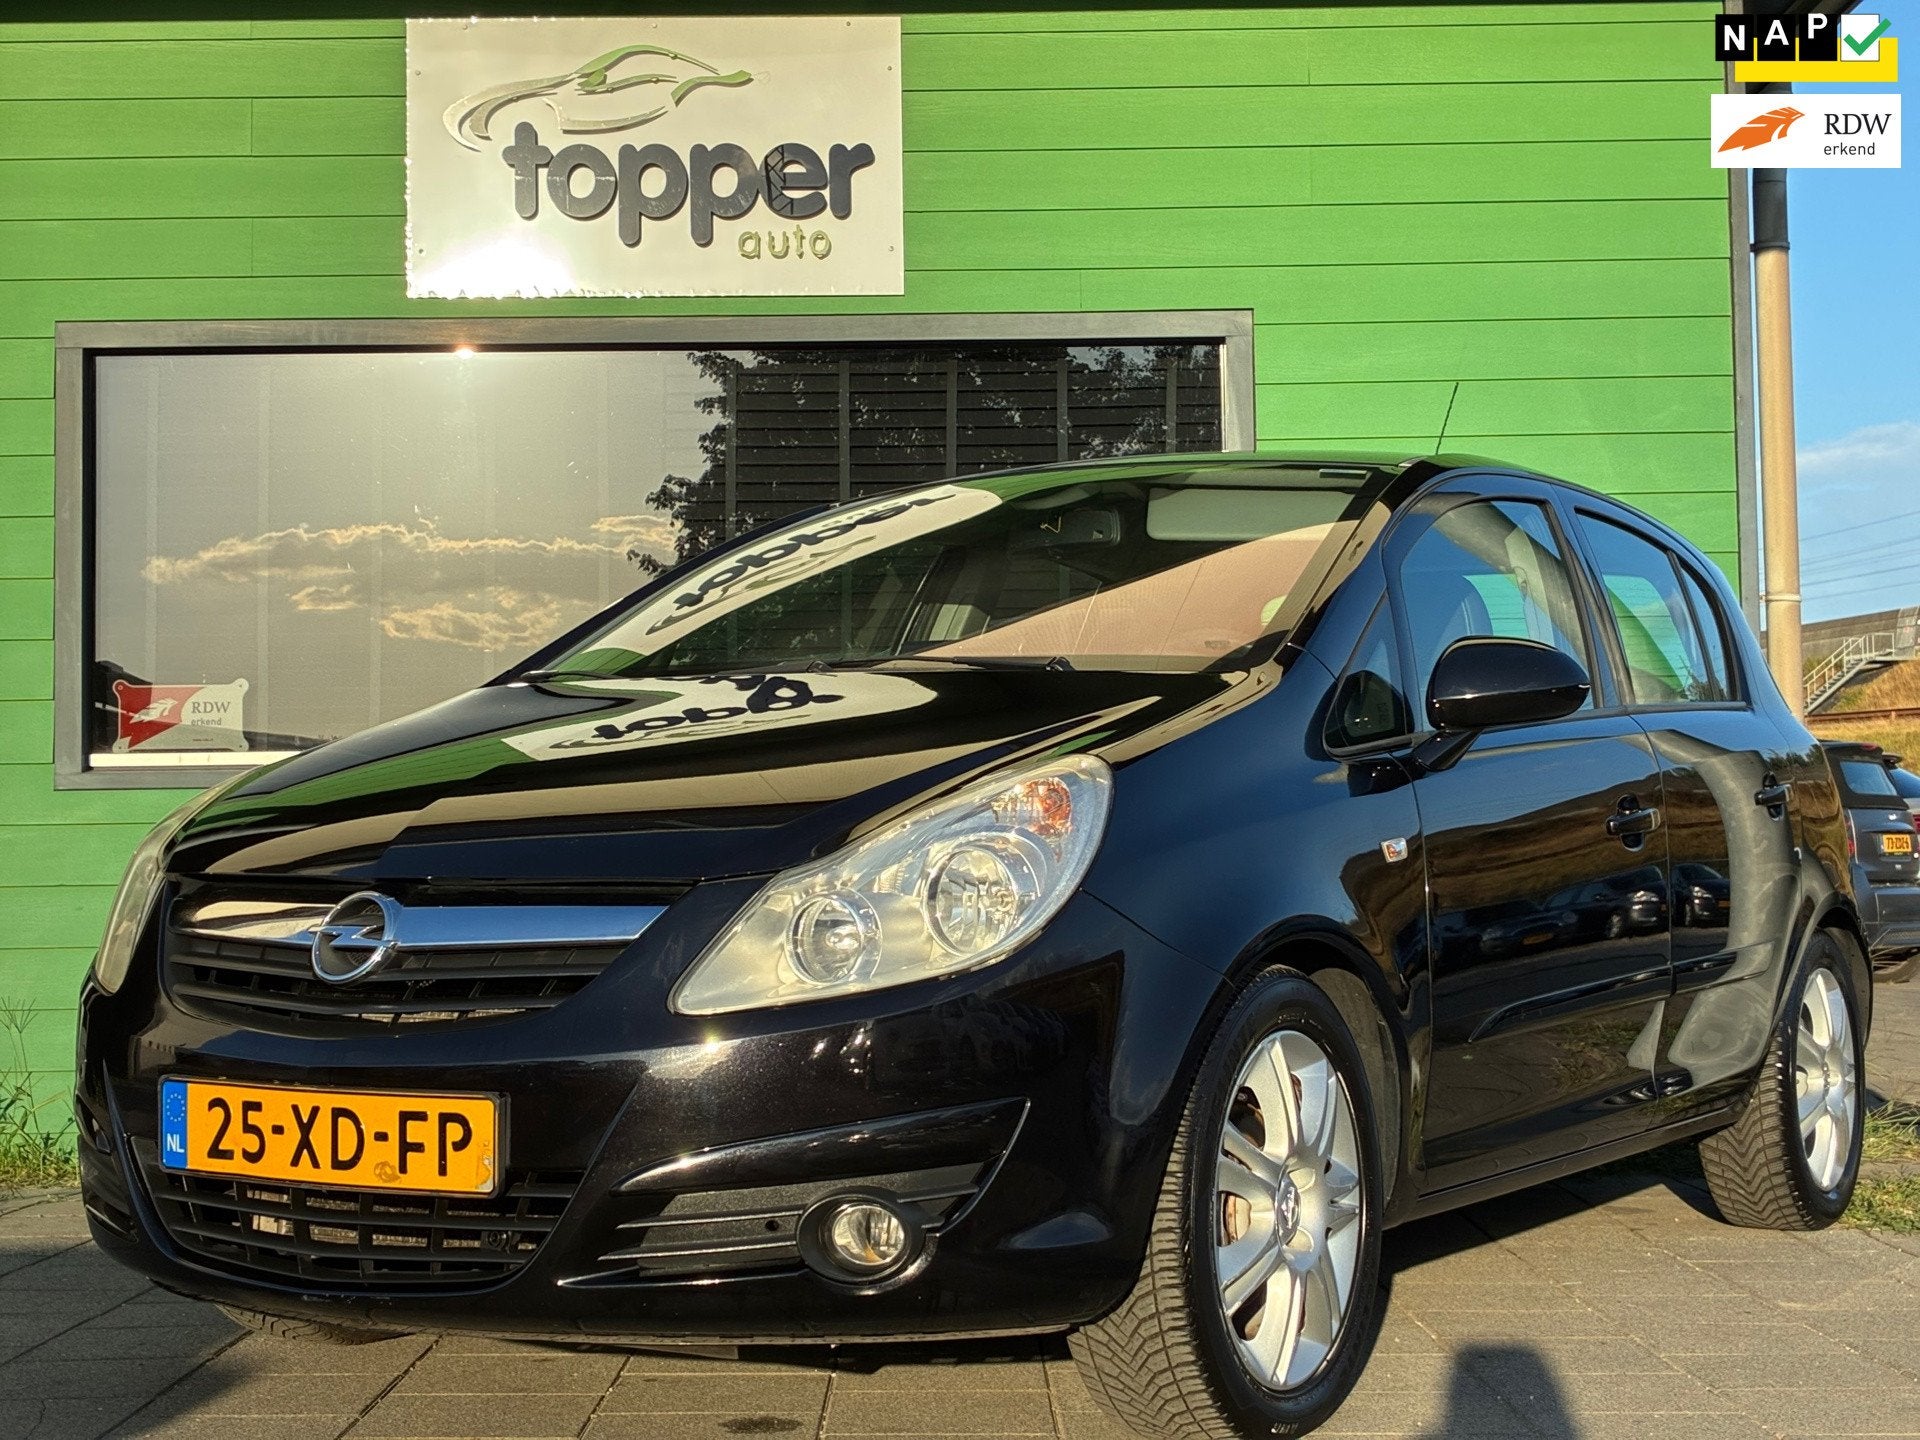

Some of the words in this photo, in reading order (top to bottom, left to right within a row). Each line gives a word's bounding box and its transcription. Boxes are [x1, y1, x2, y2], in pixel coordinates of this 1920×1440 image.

[502, 121, 875, 246] topper
[738, 225, 832, 259] auto
[191, 701, 230, 714] RDW
[191, 717, 222, 726] erkend
[166, 1134, 185, 1153] NL
[206, 1097, 473, 1177] 25-XD-FP
